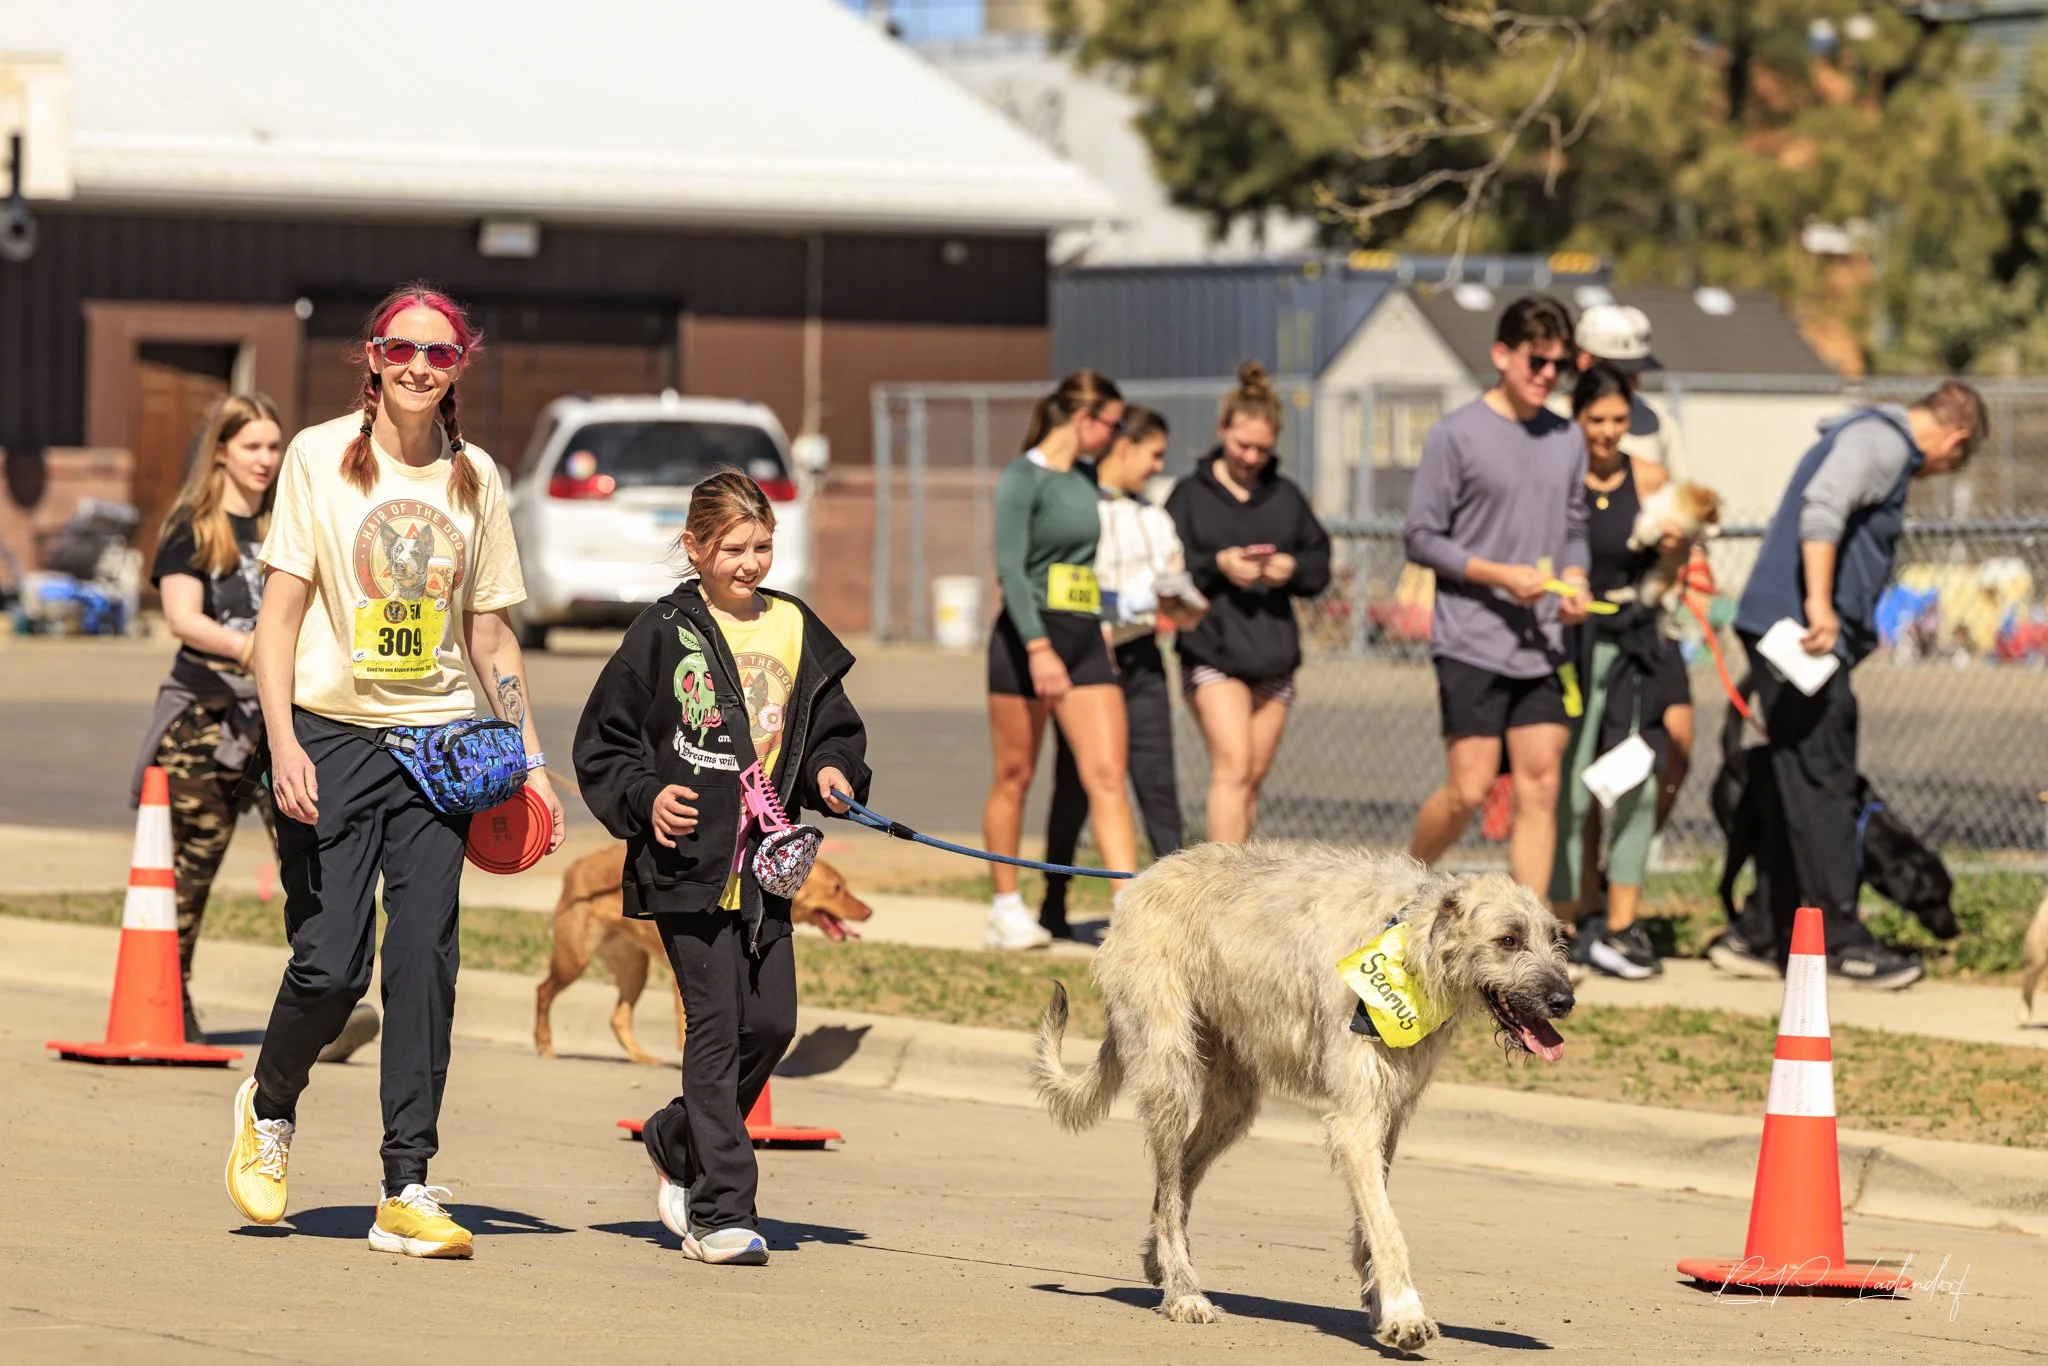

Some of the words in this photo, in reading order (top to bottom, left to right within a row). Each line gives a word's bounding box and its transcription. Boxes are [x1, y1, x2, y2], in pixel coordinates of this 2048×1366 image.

[361, 510, 388, 541] HAIR
[390, 503, 407, 515] OF
[415, 504, 441, 523] THE
[443, 523, 465, 551] DOG
[378, 627, 422, 656] 309
[750, 655, 774, 669] THE
[681, 745, 717, 764] Dreams
[719, 756, 737, 767] will
[1360, 952, 1419, 1030] Seamus
